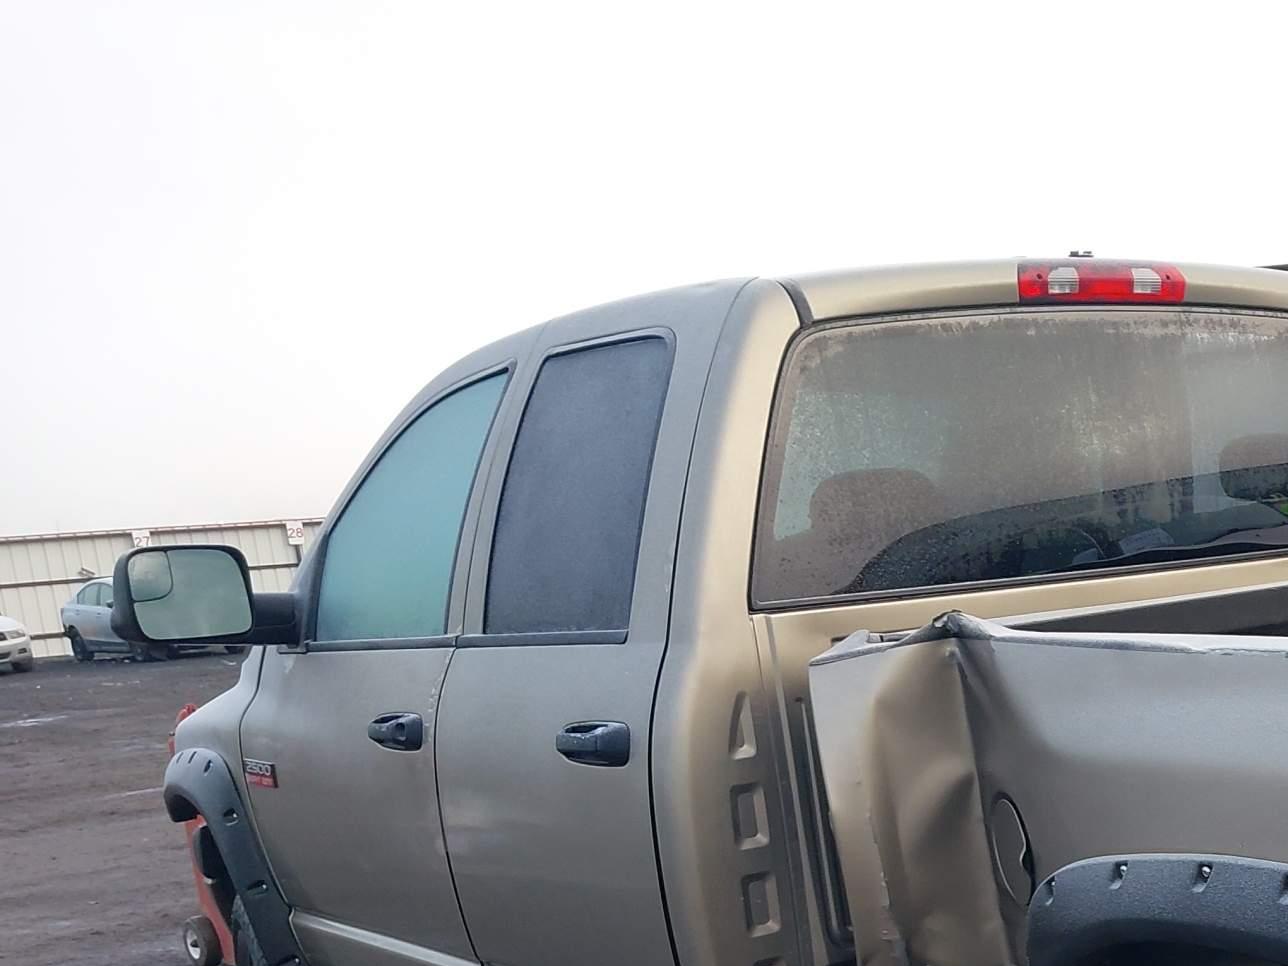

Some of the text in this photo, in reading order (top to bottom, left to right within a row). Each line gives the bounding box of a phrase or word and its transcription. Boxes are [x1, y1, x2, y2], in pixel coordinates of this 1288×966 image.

[287, 527, 304, 538] 28
[134, 536, 150, 547] 27
[246, 760, 272, 776] 2500
